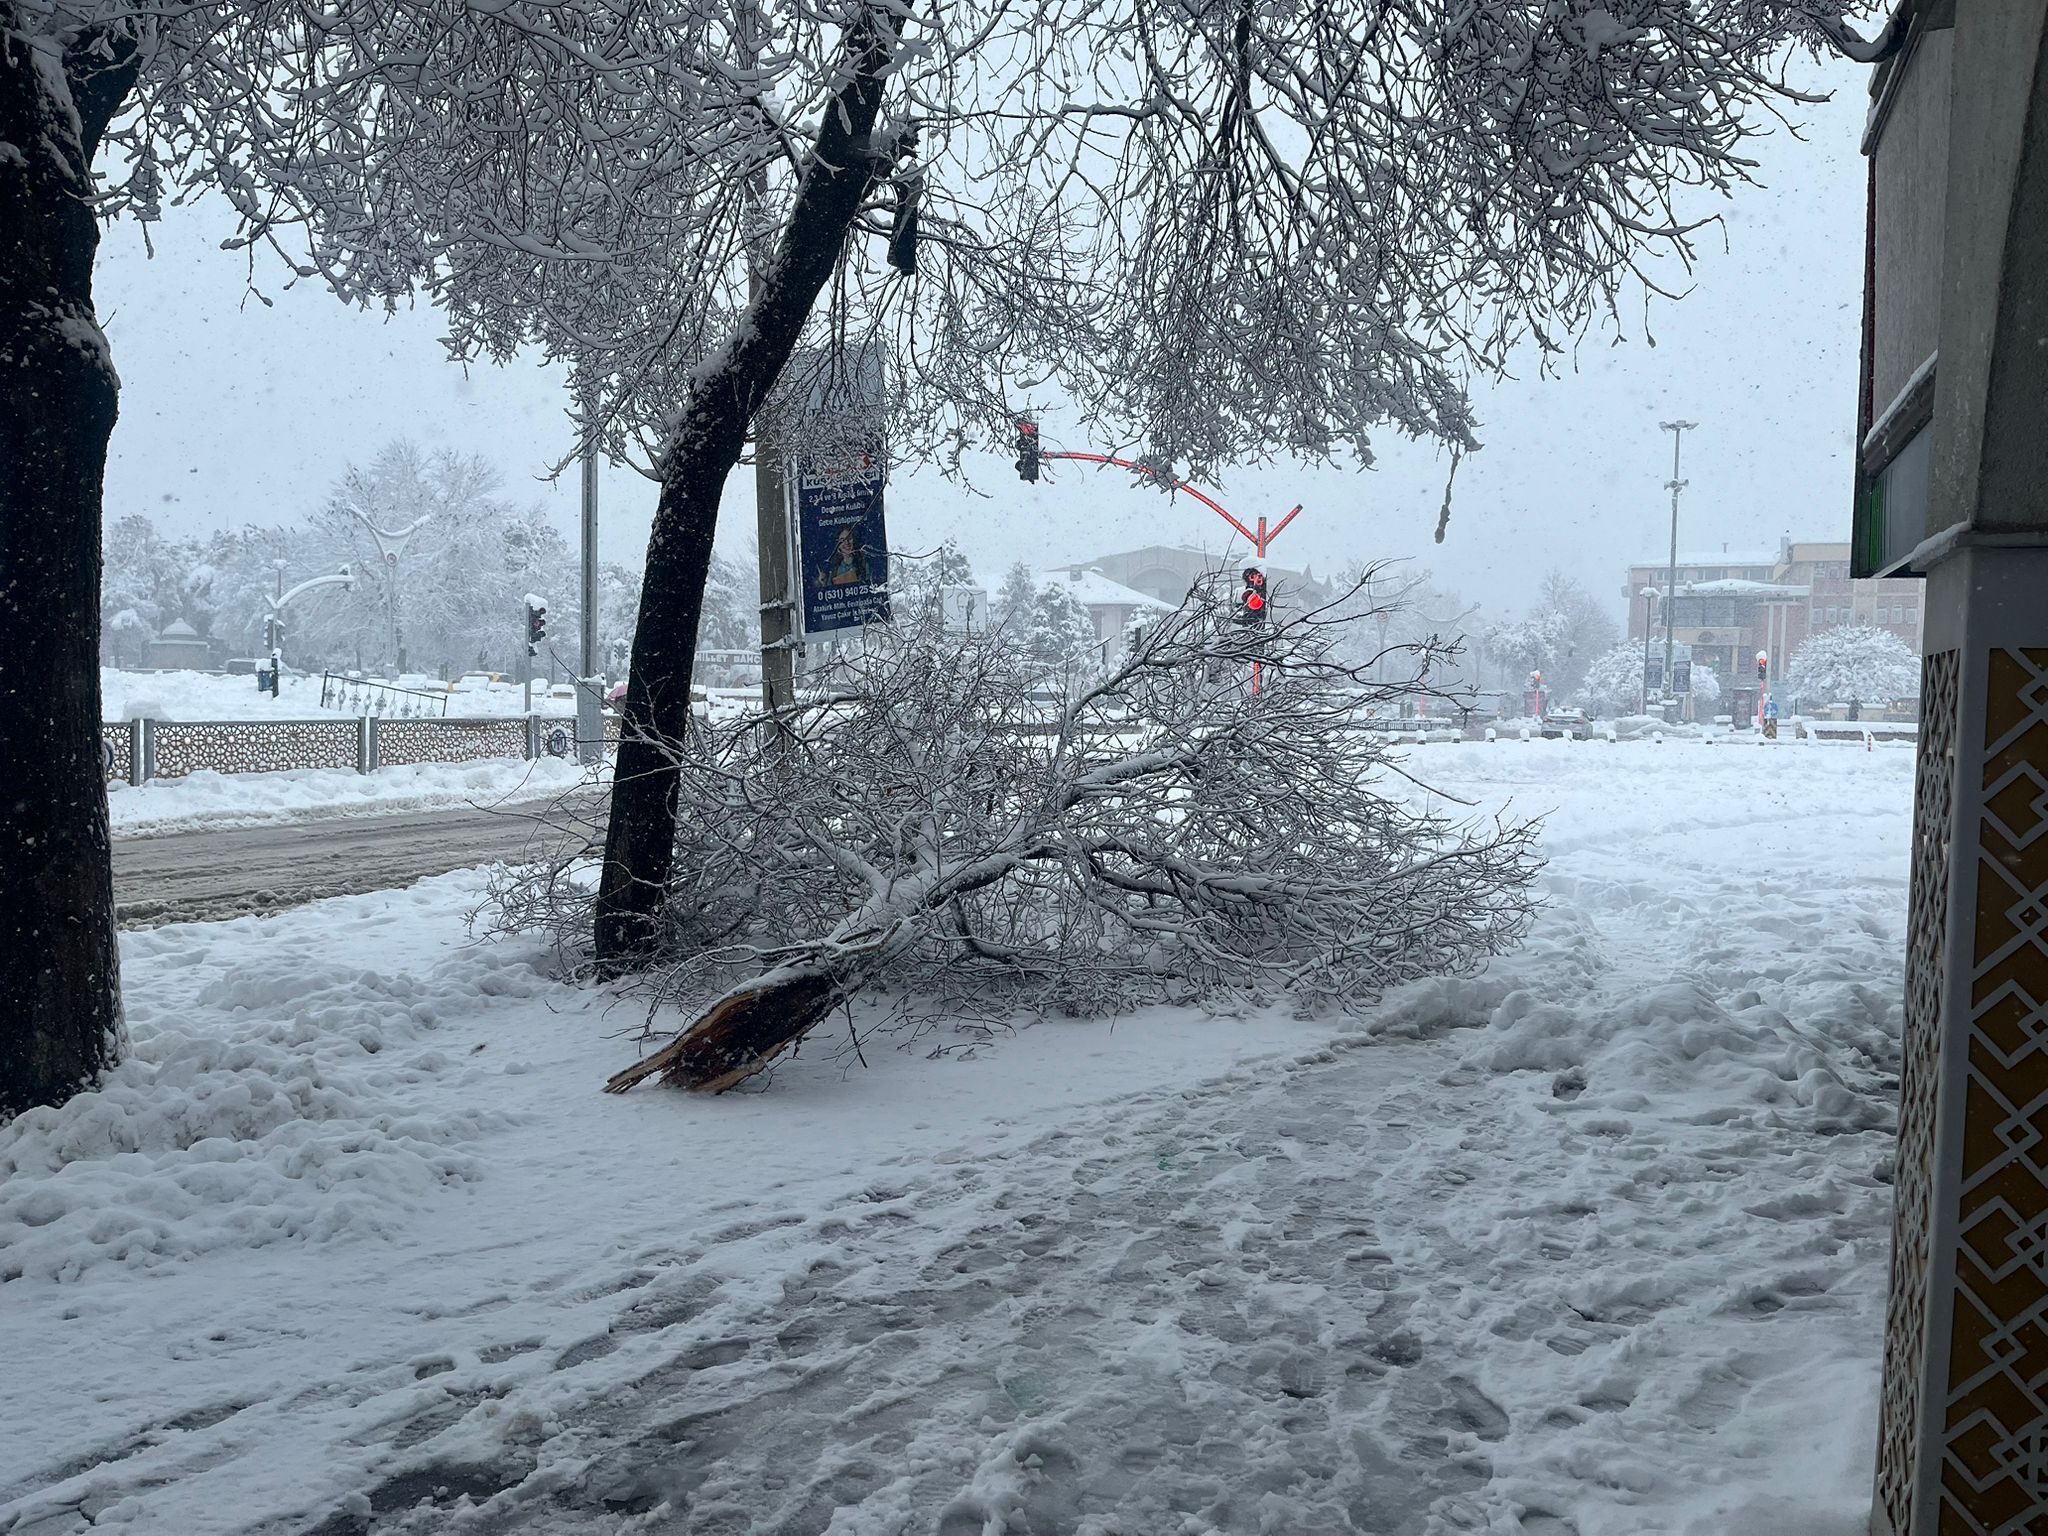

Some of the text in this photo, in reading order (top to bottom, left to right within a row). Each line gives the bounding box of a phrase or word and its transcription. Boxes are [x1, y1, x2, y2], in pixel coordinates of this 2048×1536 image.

[818, 592, 823, 600] 0
[825, 589, 843, 602] (531)
[845, 587, 858, 597] 940
[859, 584, 868, 594] 25
[734, 653, 762, 664] BAHC
